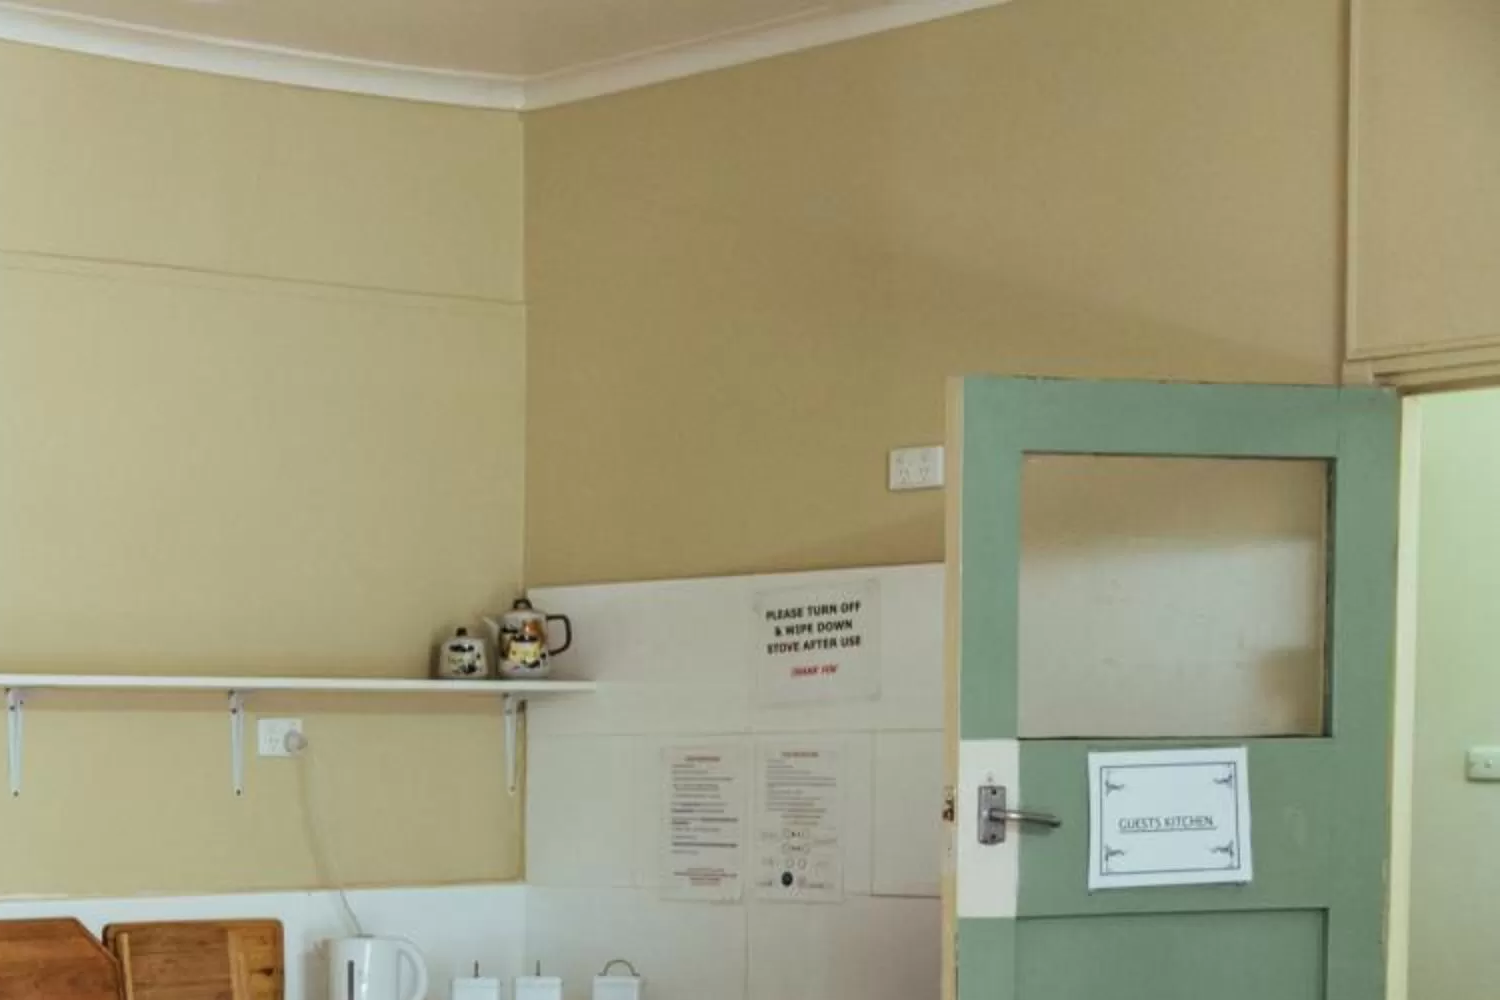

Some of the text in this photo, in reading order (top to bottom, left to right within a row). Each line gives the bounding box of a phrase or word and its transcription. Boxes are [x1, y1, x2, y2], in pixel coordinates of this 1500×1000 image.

[765, 600, 861, 620] PLEASE TURN OFF
[774, 619, 852, 637] & WIPE DOWN
[767, 635, 861, 655] STOVE AFTER USE
[1118, 815, 1213, 830] GUESTS KITCHEN
